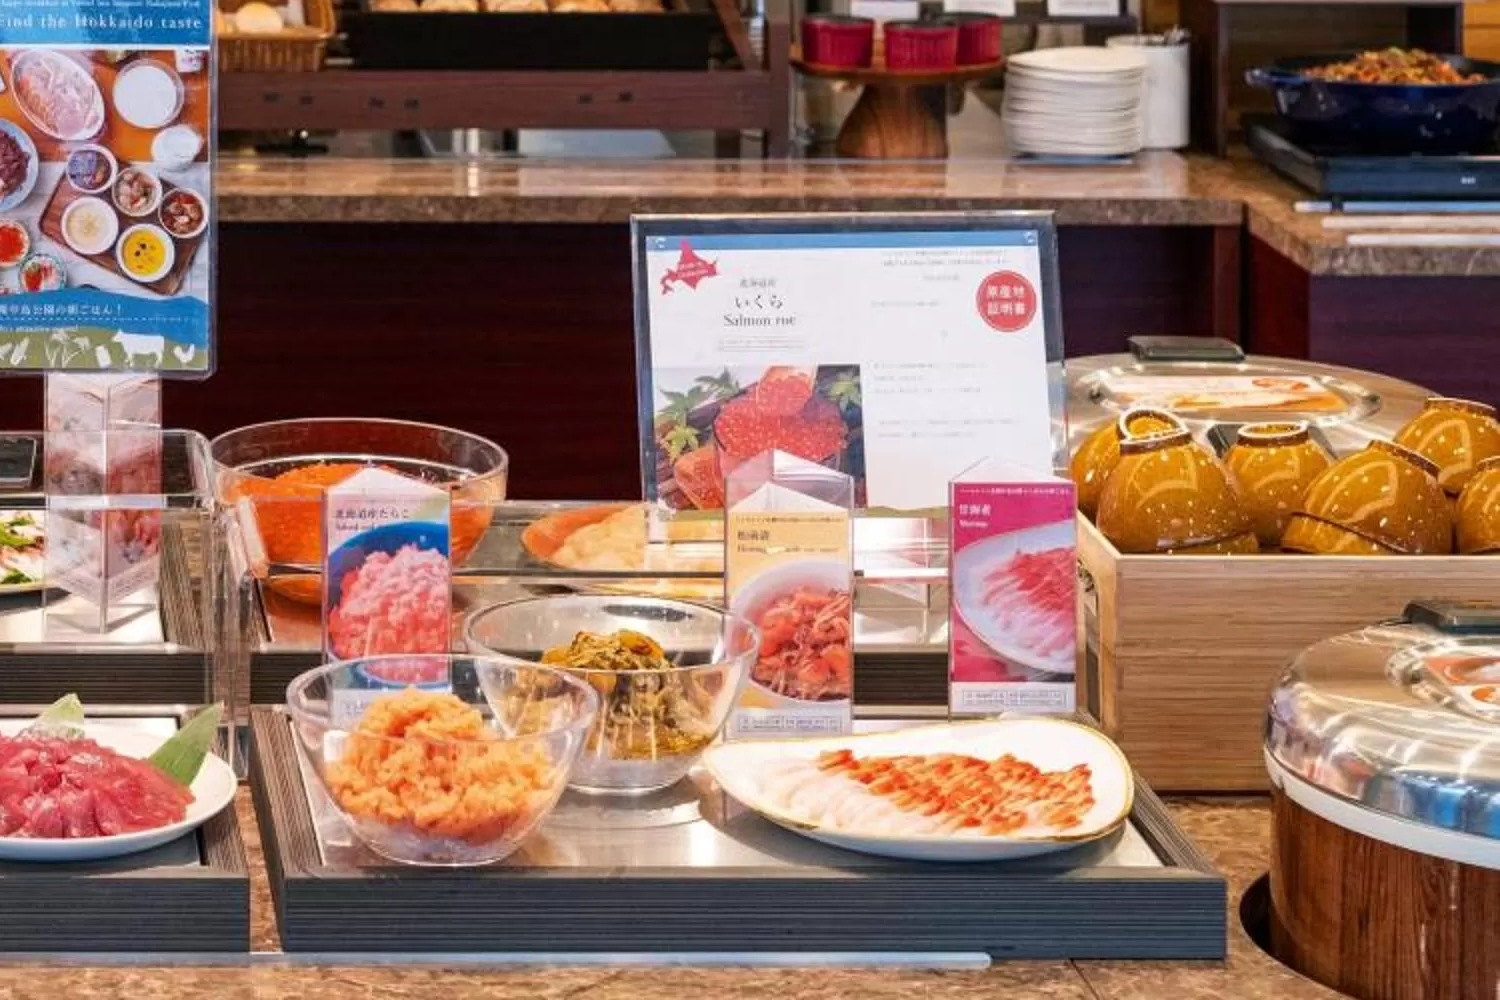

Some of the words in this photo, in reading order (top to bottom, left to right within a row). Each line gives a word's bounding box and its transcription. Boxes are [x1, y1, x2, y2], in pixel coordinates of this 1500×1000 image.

[41, 14, 68, 29] the
[75, 13, 154, 29] Hokkaido
[161, 15, 203, 29] taste
[735, 294, 783, 309] いくら
